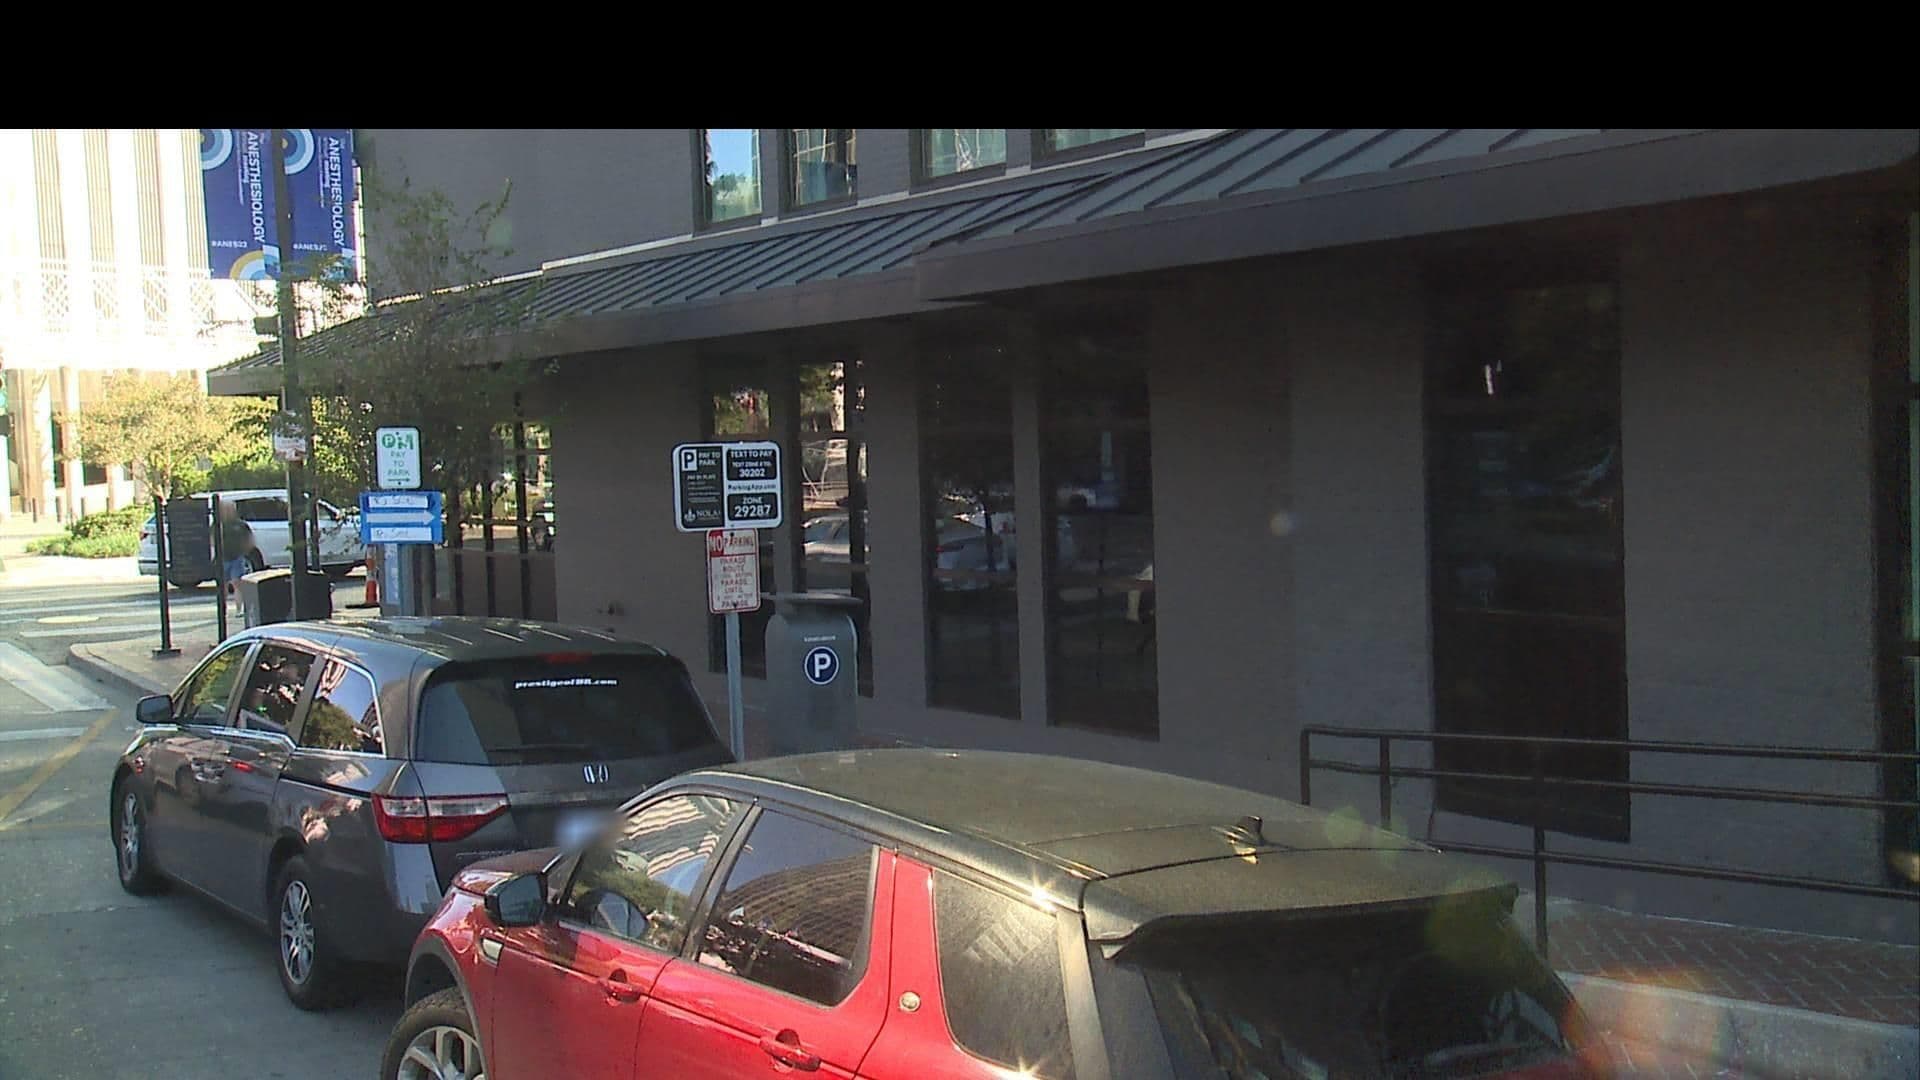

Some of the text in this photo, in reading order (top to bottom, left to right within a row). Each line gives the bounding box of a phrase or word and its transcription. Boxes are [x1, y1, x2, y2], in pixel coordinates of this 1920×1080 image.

[247, 131, 265, 242] ANESTHESIOLOGY
[328, 137, 345, 246] ANESTHESIOLOGY
[759, 450, 773, 458] PAY
[739, 468, 765, 478] 30202
[734, 504, 772, 518] 29287
[709, 535, 724, 552] NO
[814, 653, 831, 678] P
